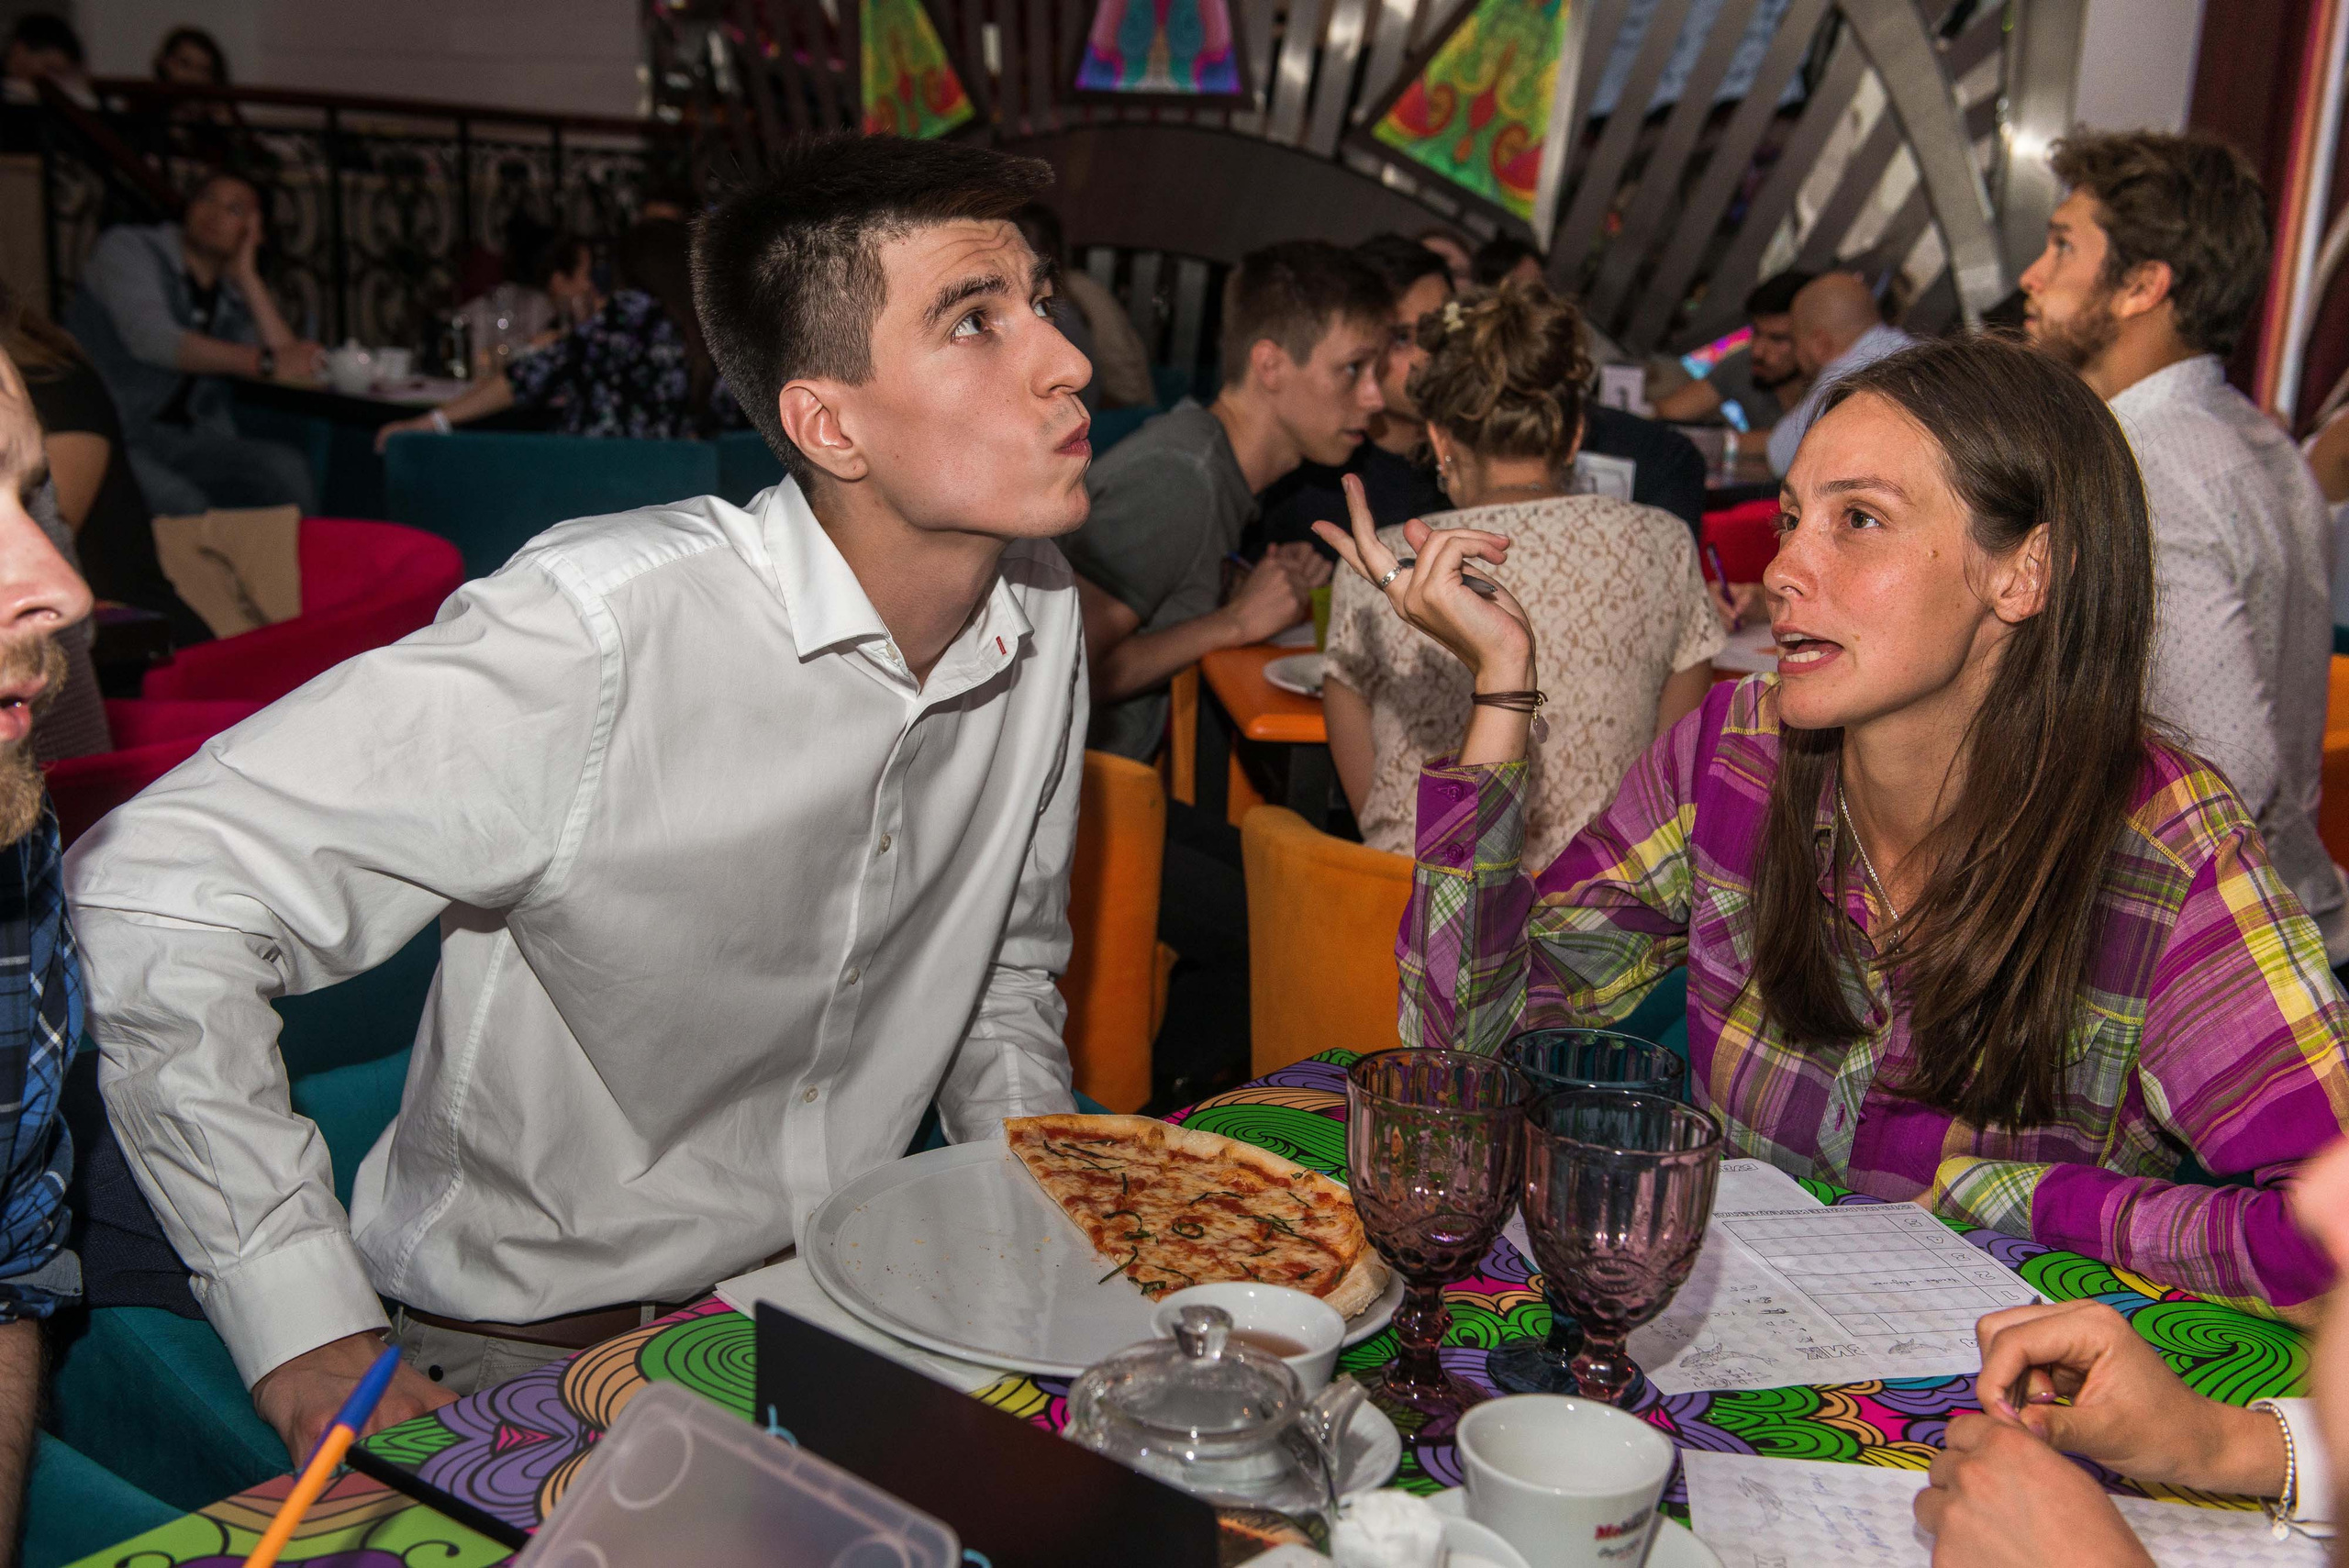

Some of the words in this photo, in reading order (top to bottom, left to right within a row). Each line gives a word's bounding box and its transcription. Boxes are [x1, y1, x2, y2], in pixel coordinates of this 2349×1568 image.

[1904, 1217, 1922, 1228] 5
[1926, 1234, 1944, 1245] 4
[1950, 1251, 1972, 1262] 3
[1974, 1270, 1996, 1280] 2
[2000, 1290, 2020, 1300] 1
